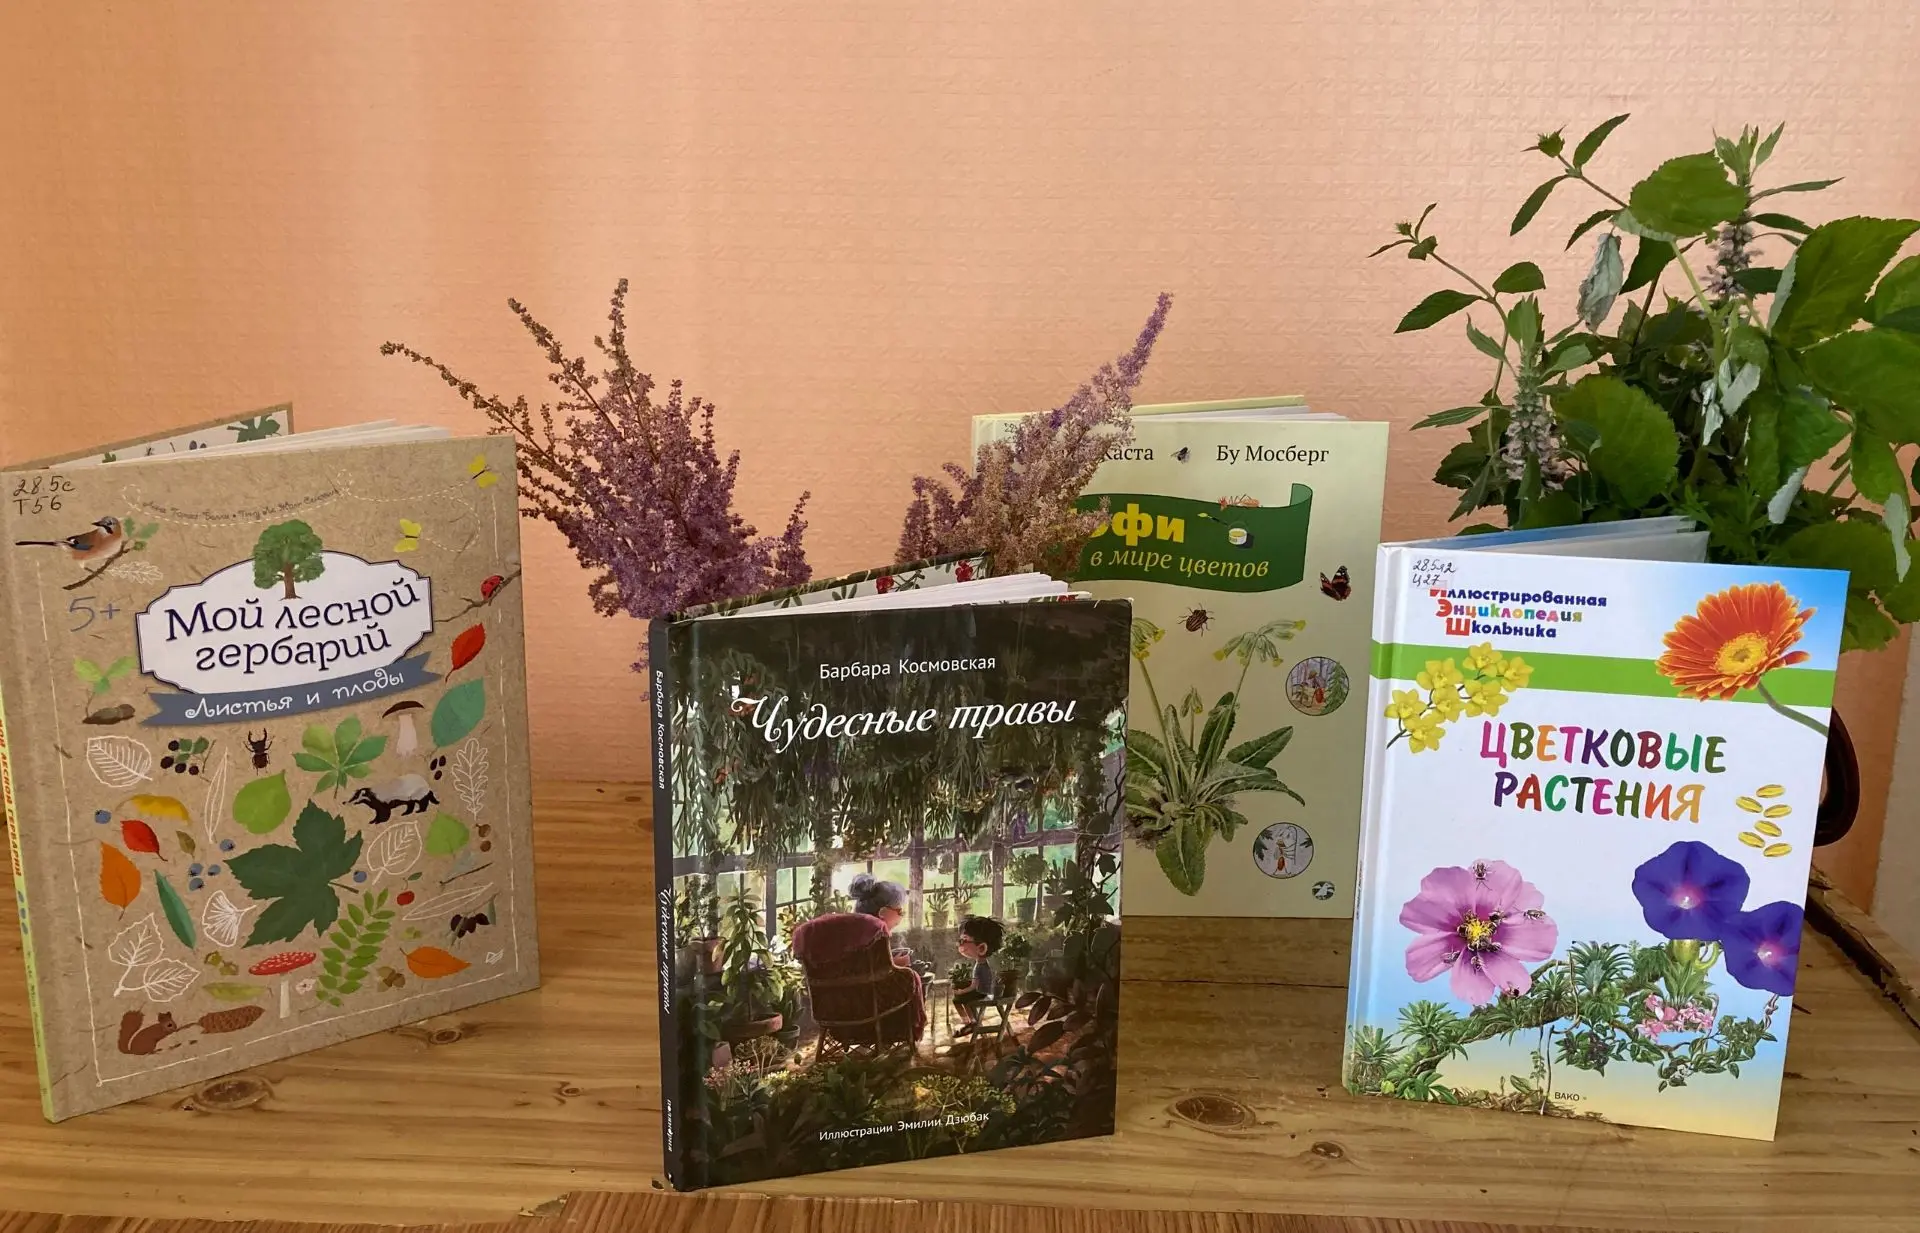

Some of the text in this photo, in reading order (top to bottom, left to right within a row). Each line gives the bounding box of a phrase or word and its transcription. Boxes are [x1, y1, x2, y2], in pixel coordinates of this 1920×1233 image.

[1216, 445, 1241, 465] Бу
[1245, 445, 1329, 465] Мосберг
[1068, 503, 1185, 546] фи
[1090, 551, 1270, 578] в мире цветов
[69, 596, 120, 632] 5+
[165, 577, 421, 641] Мой лесной
[1436, 598, 1582, 622] Энциклопедия
[1446, 617, 1557, 638] Школьника
[196, 622, 391, 674] гербарий
[820, 657, 996, 682] Барбара Космовская
[185, 667, 405, 719] Листья и плоды
[656, 670, 665, 789] Барбара Космовская
[731, 696, 1077, 754] Чудесные травы
[1480, 720, 1727, 773] ЦВЕТКОВЫЕ
[1494, 771, 1705, 823] РАСТЕНИЯ
[659, 887, 672, 1014] Чудесные травы
[1554, 1091, 1580, 1102] ВАКО
[819, 1112, 990, 1141] Иллюстрации Эмилии Дзюбак
